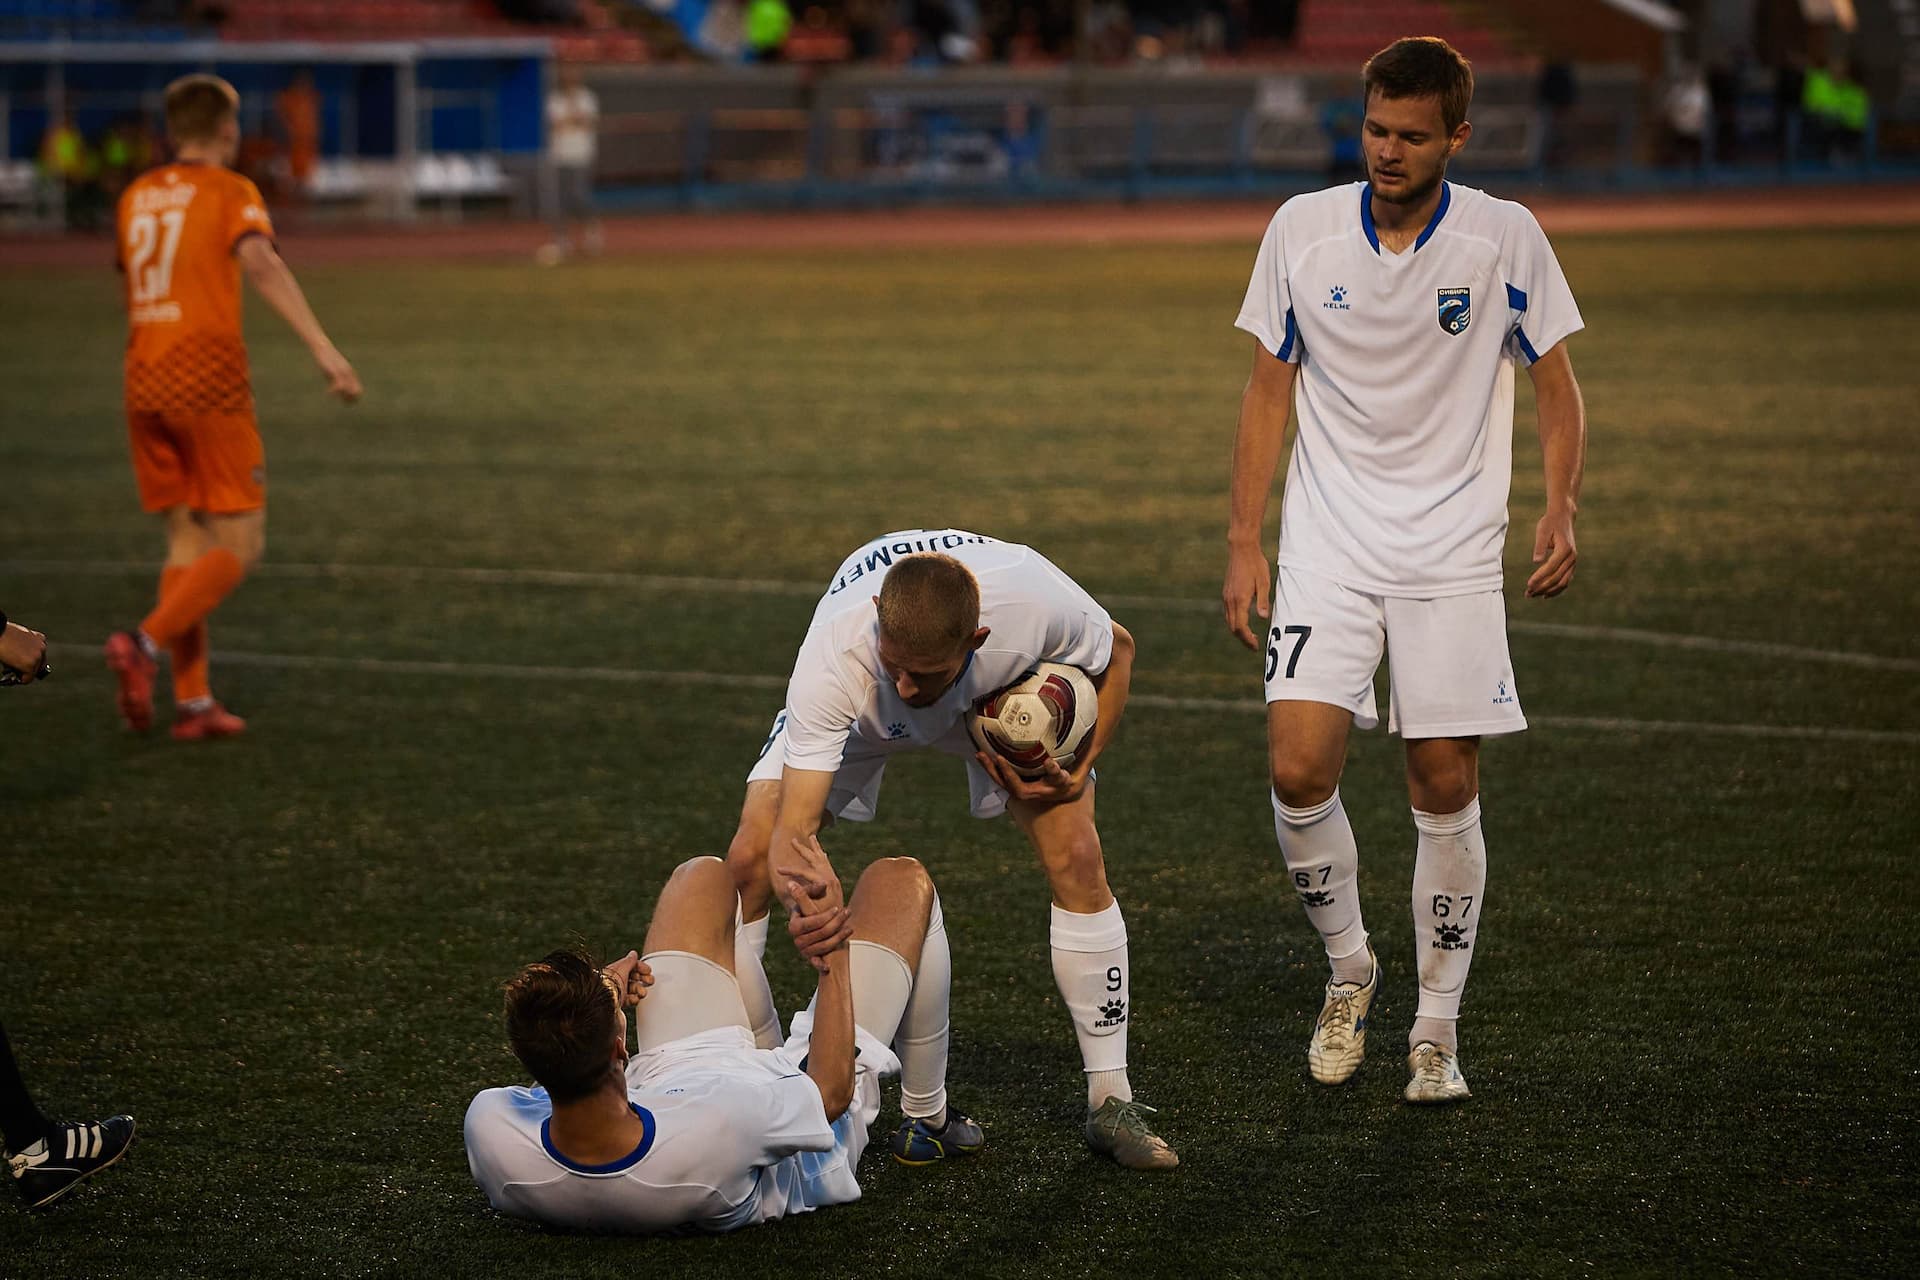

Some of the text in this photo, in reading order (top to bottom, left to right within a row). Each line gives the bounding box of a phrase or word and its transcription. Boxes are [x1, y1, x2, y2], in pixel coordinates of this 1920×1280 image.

[128, 210, 186, 301] 21
[1323, 302, 1351, 310] KELME
[1266, 625, 1312, 682] 67
[1296, 865, 1332, 888] 67
[1433, 894, 1473, 918] 67
[1106, 966, 1122, 992] 9
